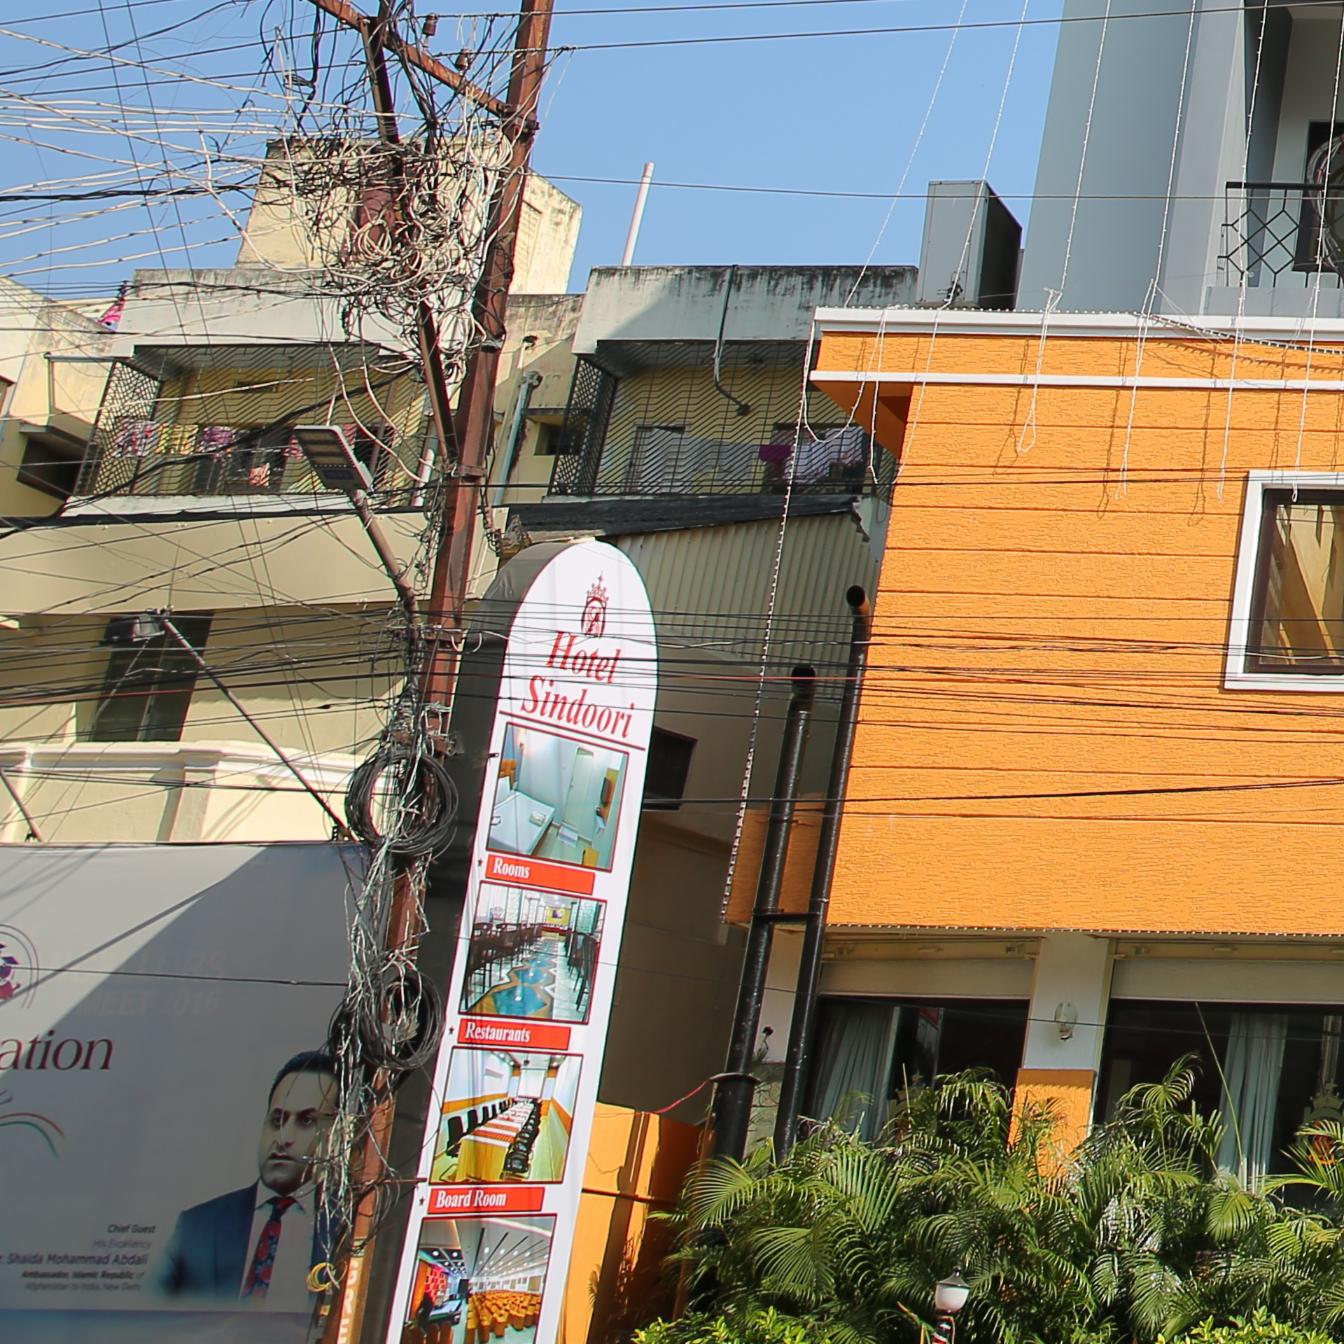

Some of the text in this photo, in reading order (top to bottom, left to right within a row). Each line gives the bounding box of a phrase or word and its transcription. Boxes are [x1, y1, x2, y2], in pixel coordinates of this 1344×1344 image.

[546, 630, 622, 684] Hotel
[520, 675, 635, 738] Sindoori
[492, 856, 531, 879] Rooms
[464, 1022, 532, 1043] Restaurants
[435, 1190, 507, 1208] Board Room
